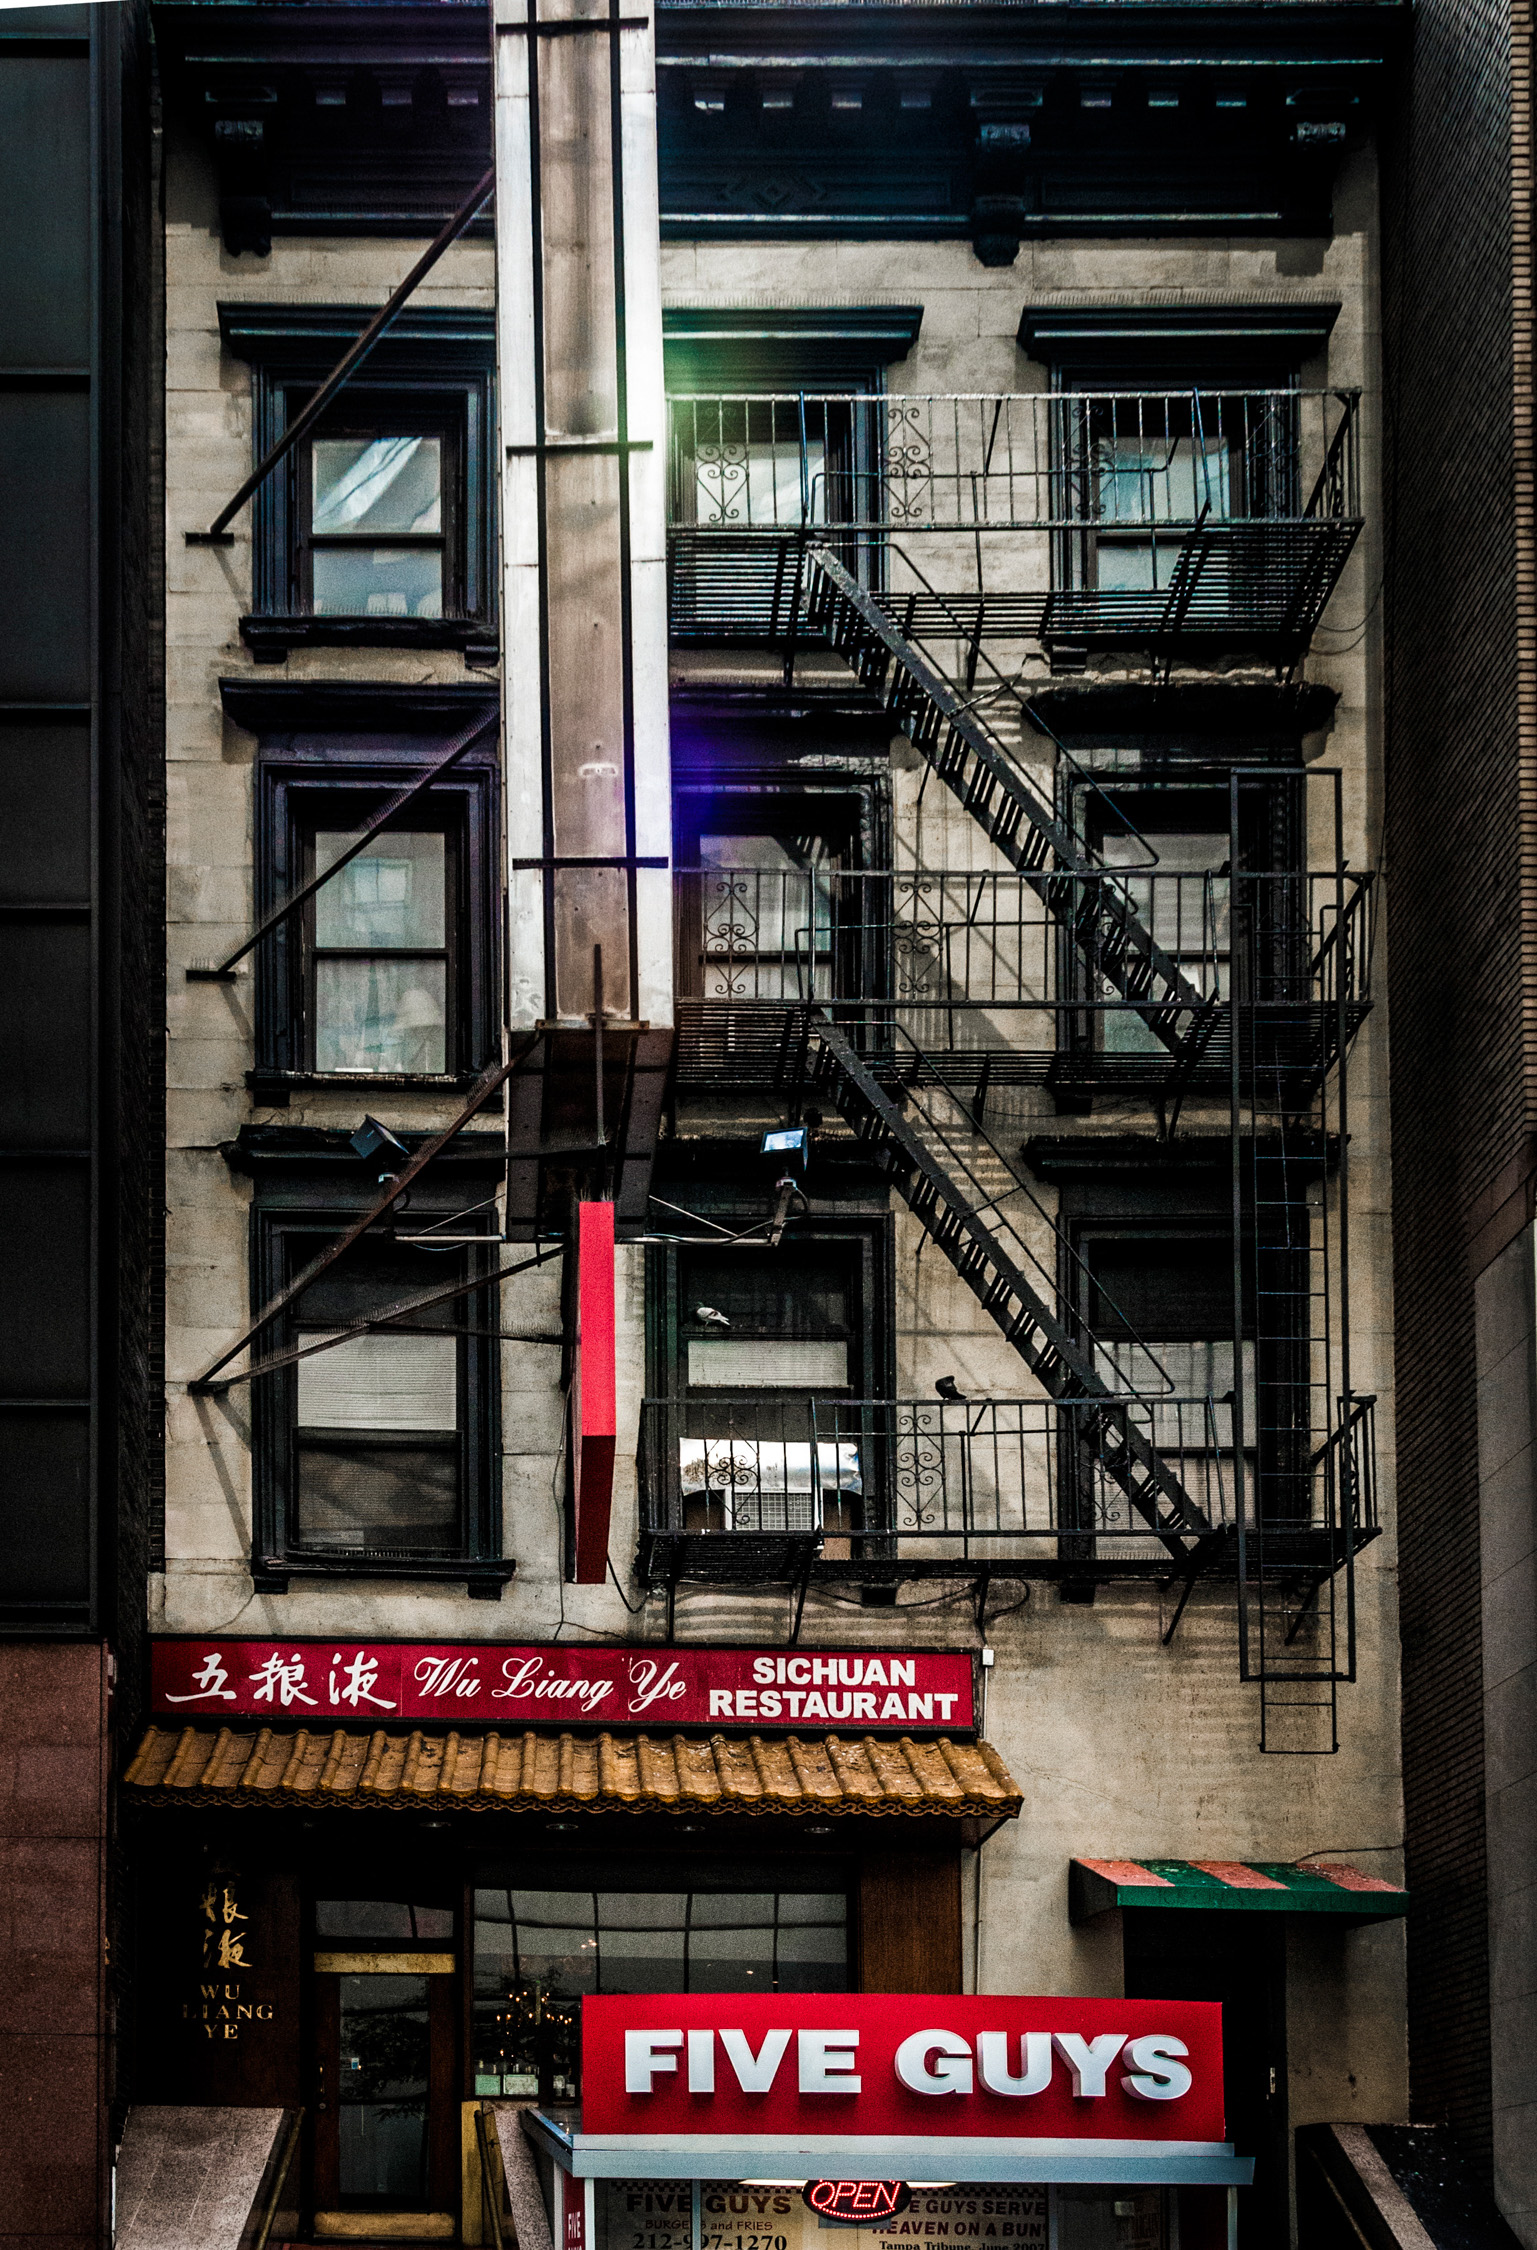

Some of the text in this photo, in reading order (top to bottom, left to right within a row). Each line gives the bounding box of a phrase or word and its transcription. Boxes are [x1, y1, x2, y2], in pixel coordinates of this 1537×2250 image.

[752, 1657, 916, 1687] SICHUAN
[413, 1656, 687, 1713] Wu Liang Ye
[709, 1688, 959, 1721] RESTAURANT
[200, 1984, 241, 2000] WU
[181, 2003, 274, 2020] LIANG
[203, 2024, 239, 2040] YE
[624, 2028, 1192, 2101] FIVE GUYS
[626, 2194, 792, 2214] FIVE GUYS
[811, 2181, 901, 2208] OPEN
[926, 2200, 979, 2215] GUYS
[982, 2201, 1046, 2216] SERVE
[568, 2211, 581, 2240] FIVE
[645, 2220, 773, 2231] BURGES and FRIES
[954, 2221, 980, 2236] ON
[985, 2222, 997, 2236] A
